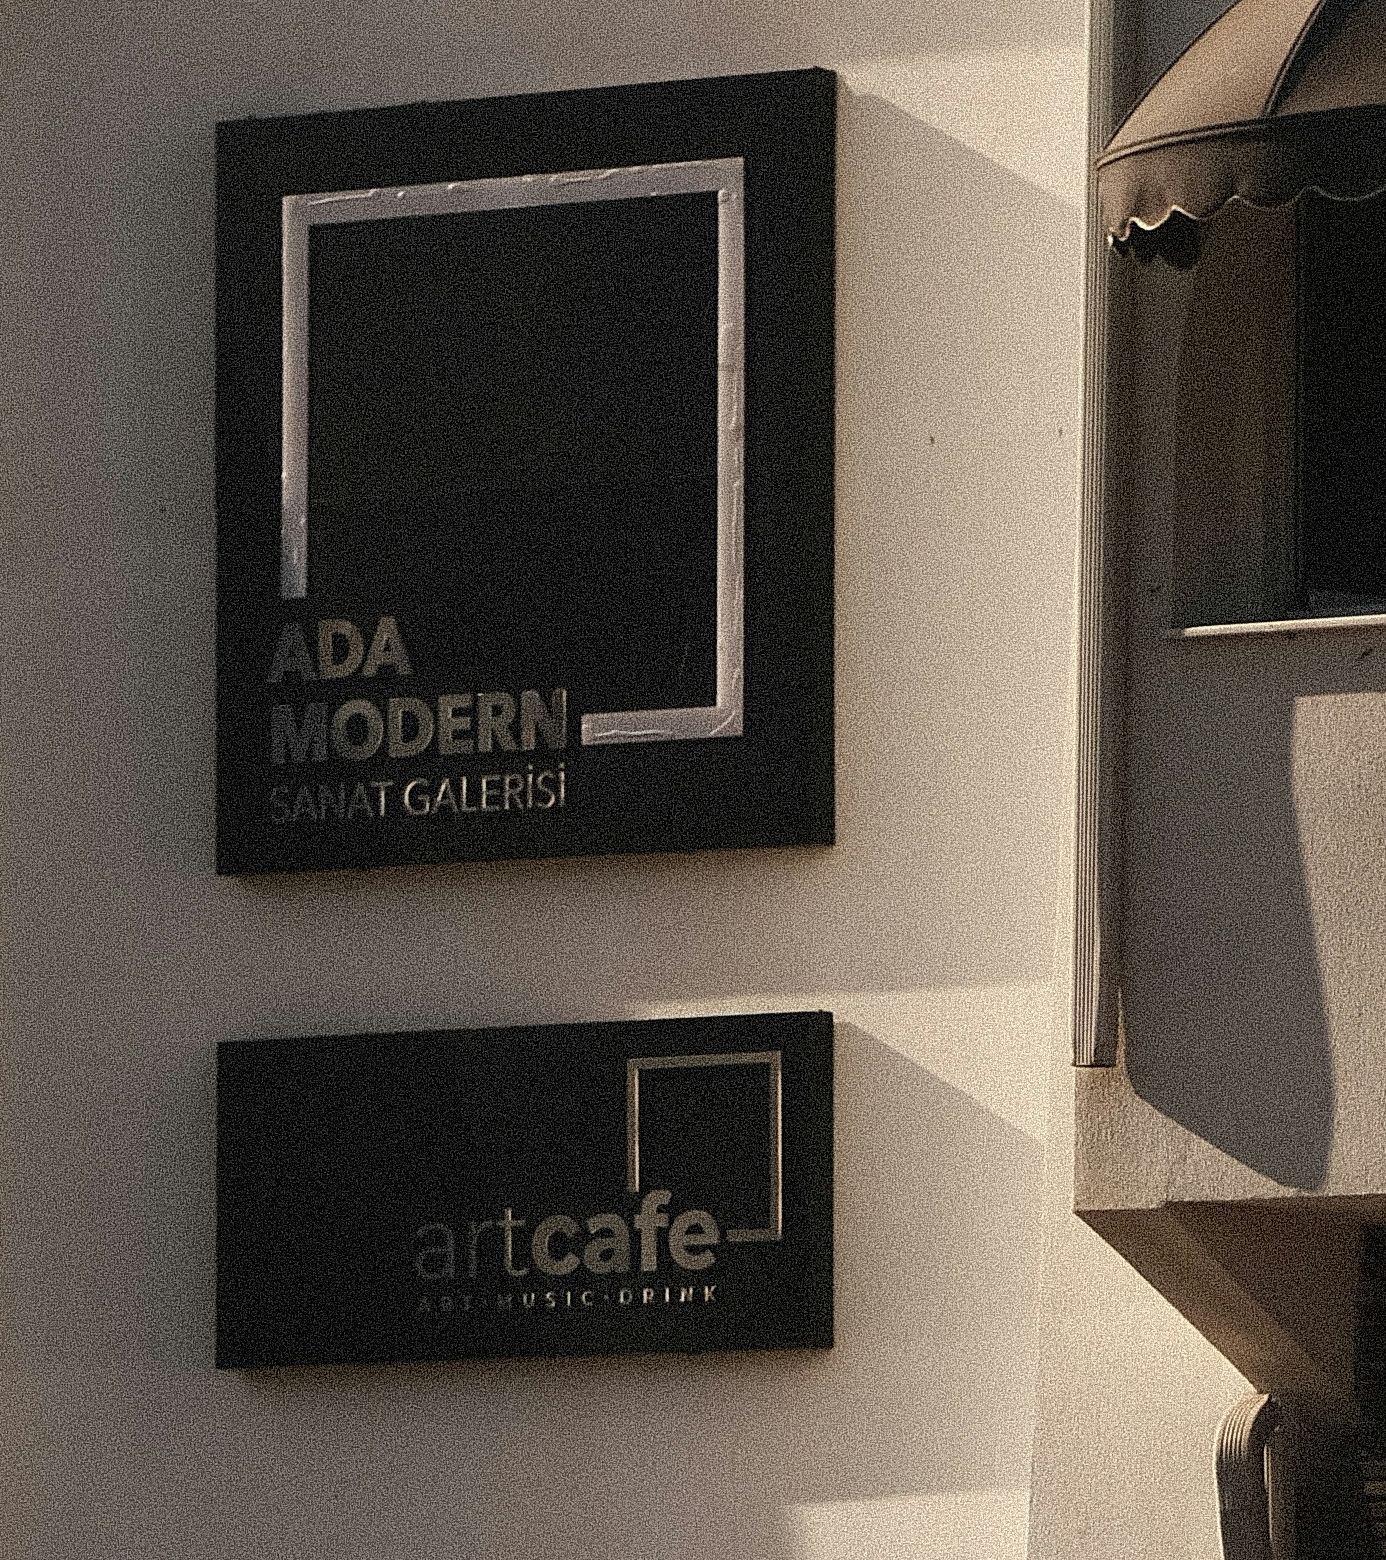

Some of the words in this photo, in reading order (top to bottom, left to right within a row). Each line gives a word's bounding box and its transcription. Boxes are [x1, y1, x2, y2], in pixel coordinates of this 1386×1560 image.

[268, 615, 412, 682] ADA
[268, 686, 568, 765] MODERN
[268, 779, 395, 826] SANAT
[415, 1189, 721, 1279] artcafe
